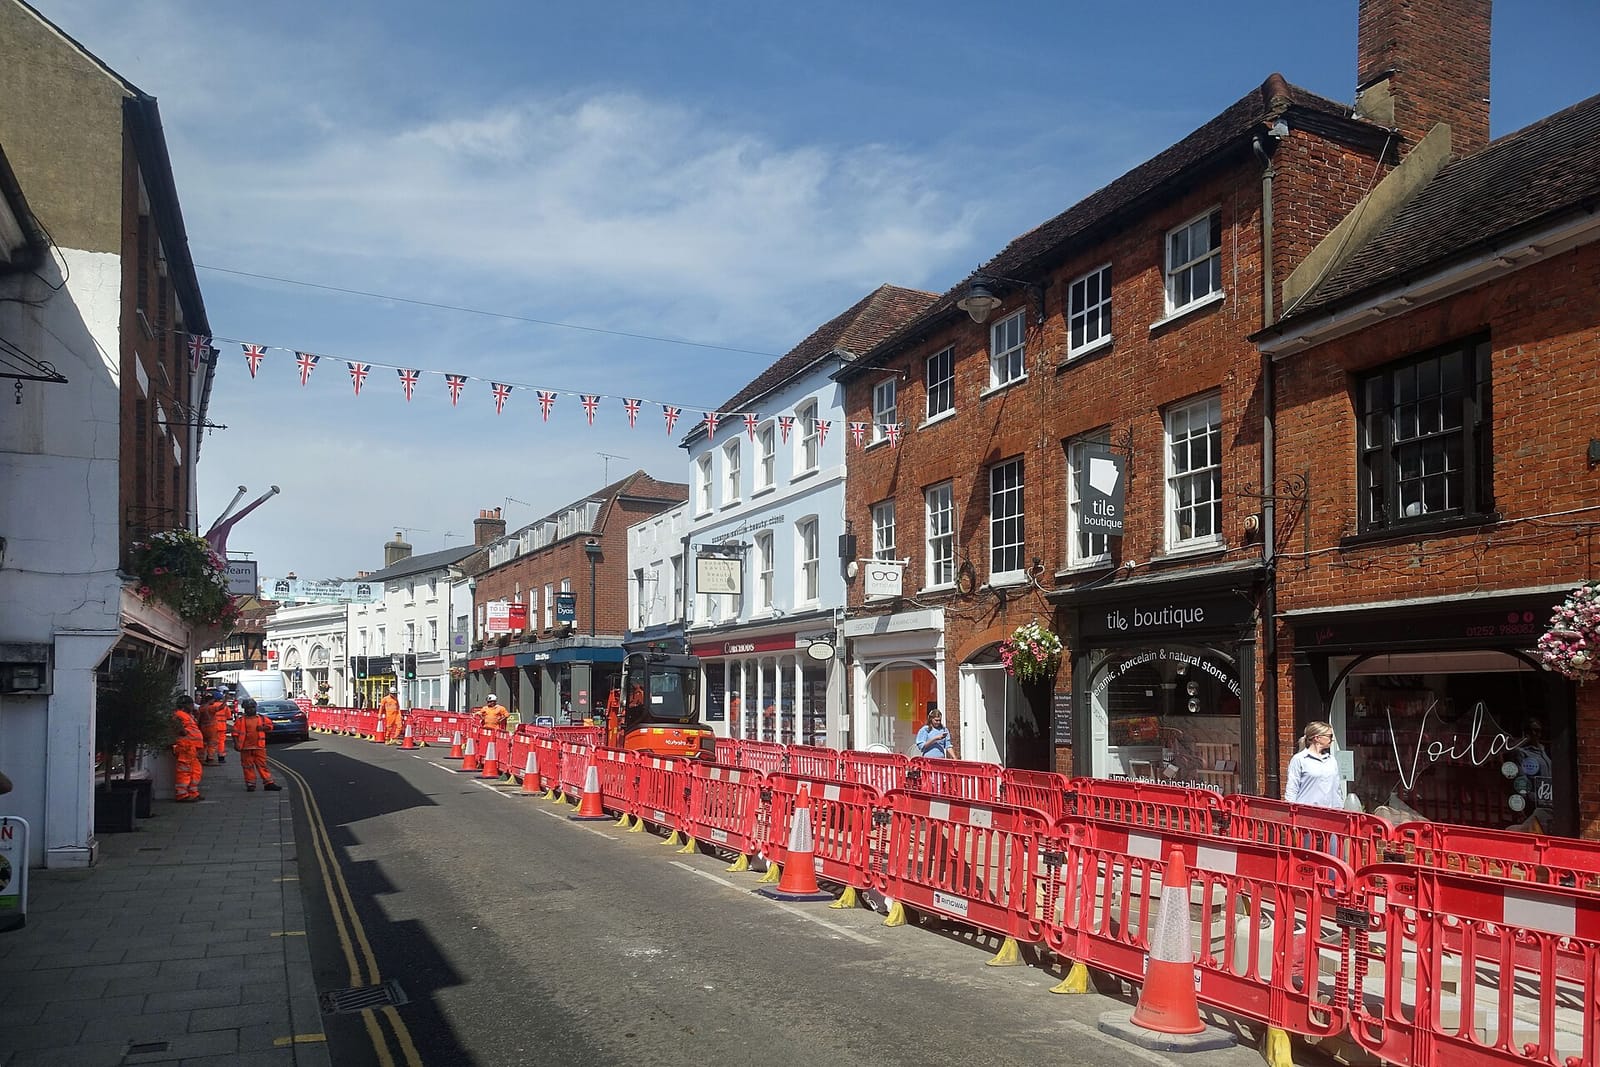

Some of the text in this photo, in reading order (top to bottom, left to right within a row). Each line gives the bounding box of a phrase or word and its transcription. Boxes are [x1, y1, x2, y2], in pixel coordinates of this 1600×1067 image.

[1092, 499, 1115, 516] tile
[1084, 514, 1123, 529] boutique
[1106, 605, 1204, 630] tile boutique
[1466, 625, 1495, 636] 01252
[1093, 670, 1116, 697] eramic
[1120, 650, 1157, 674] porcelain
[1159, 648, 1167, 660] &
[1169, 651, 1201, 667] natural
[1201, 661, 1227, 683] stone
[1227, 678, 1242, 700] tile
[1386, 700, 1527, 790] Voila
[1157, 778, 1167, 786] to
[1169, 779, 1220, 793] installation
